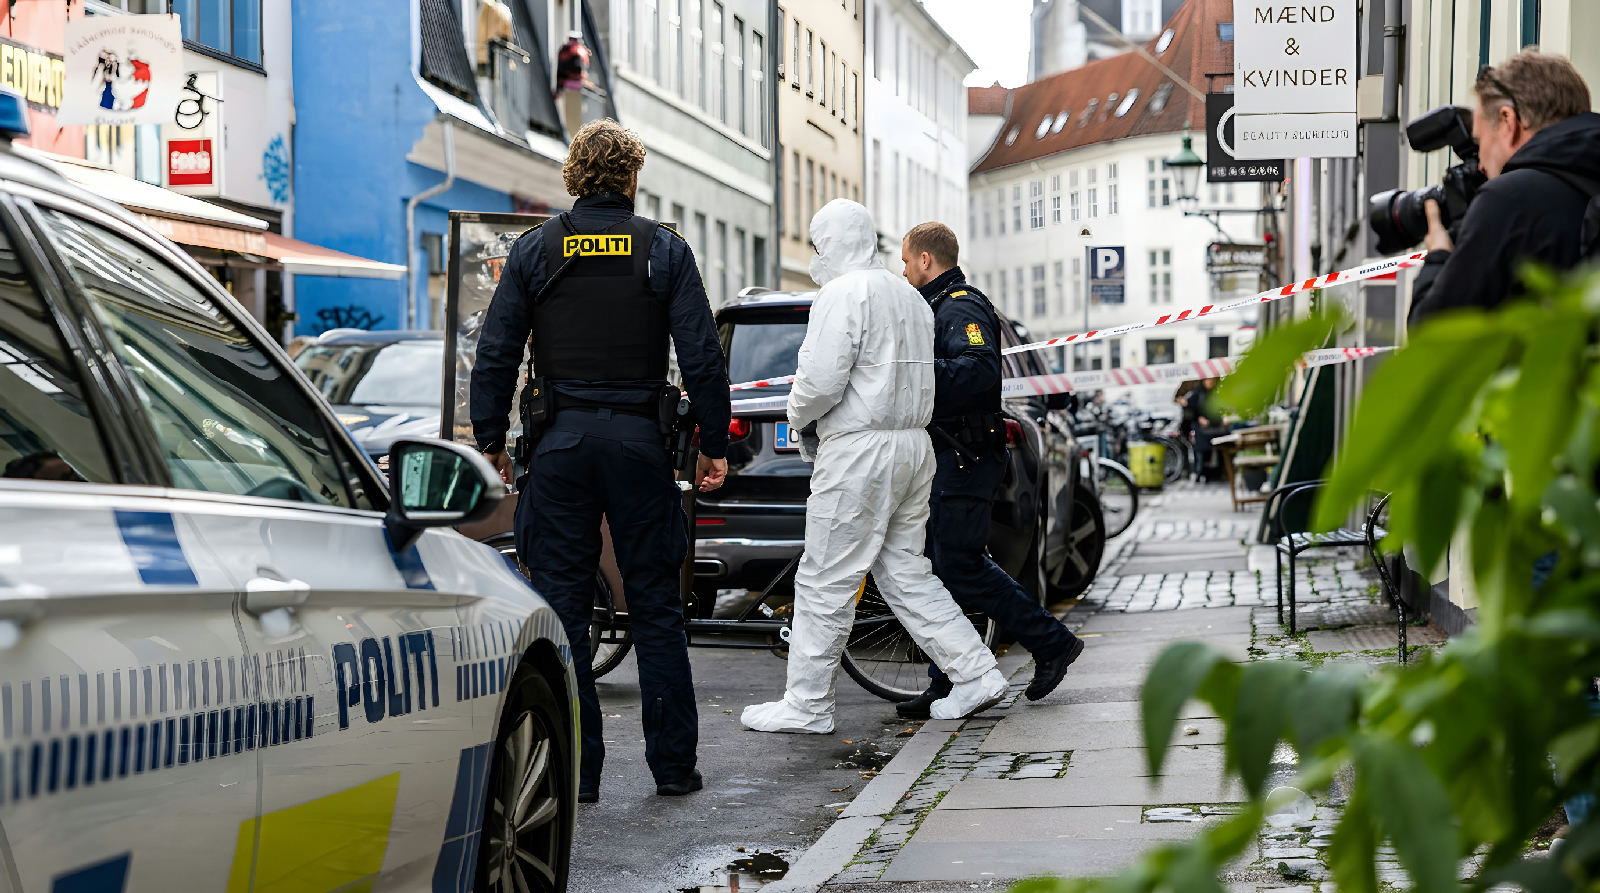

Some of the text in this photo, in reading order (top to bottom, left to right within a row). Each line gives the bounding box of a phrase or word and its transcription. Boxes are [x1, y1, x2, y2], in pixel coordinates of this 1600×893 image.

[1255, 5, 1335, 24] MÆND
[1284, 37, 1300, 56] &
[1243, 68, 1348, 88] KVINDER
[566, 237, 629, 254] POLITI
[1096, 248, 1120, 279] P
[331, 629, 440, 731] POLITI
